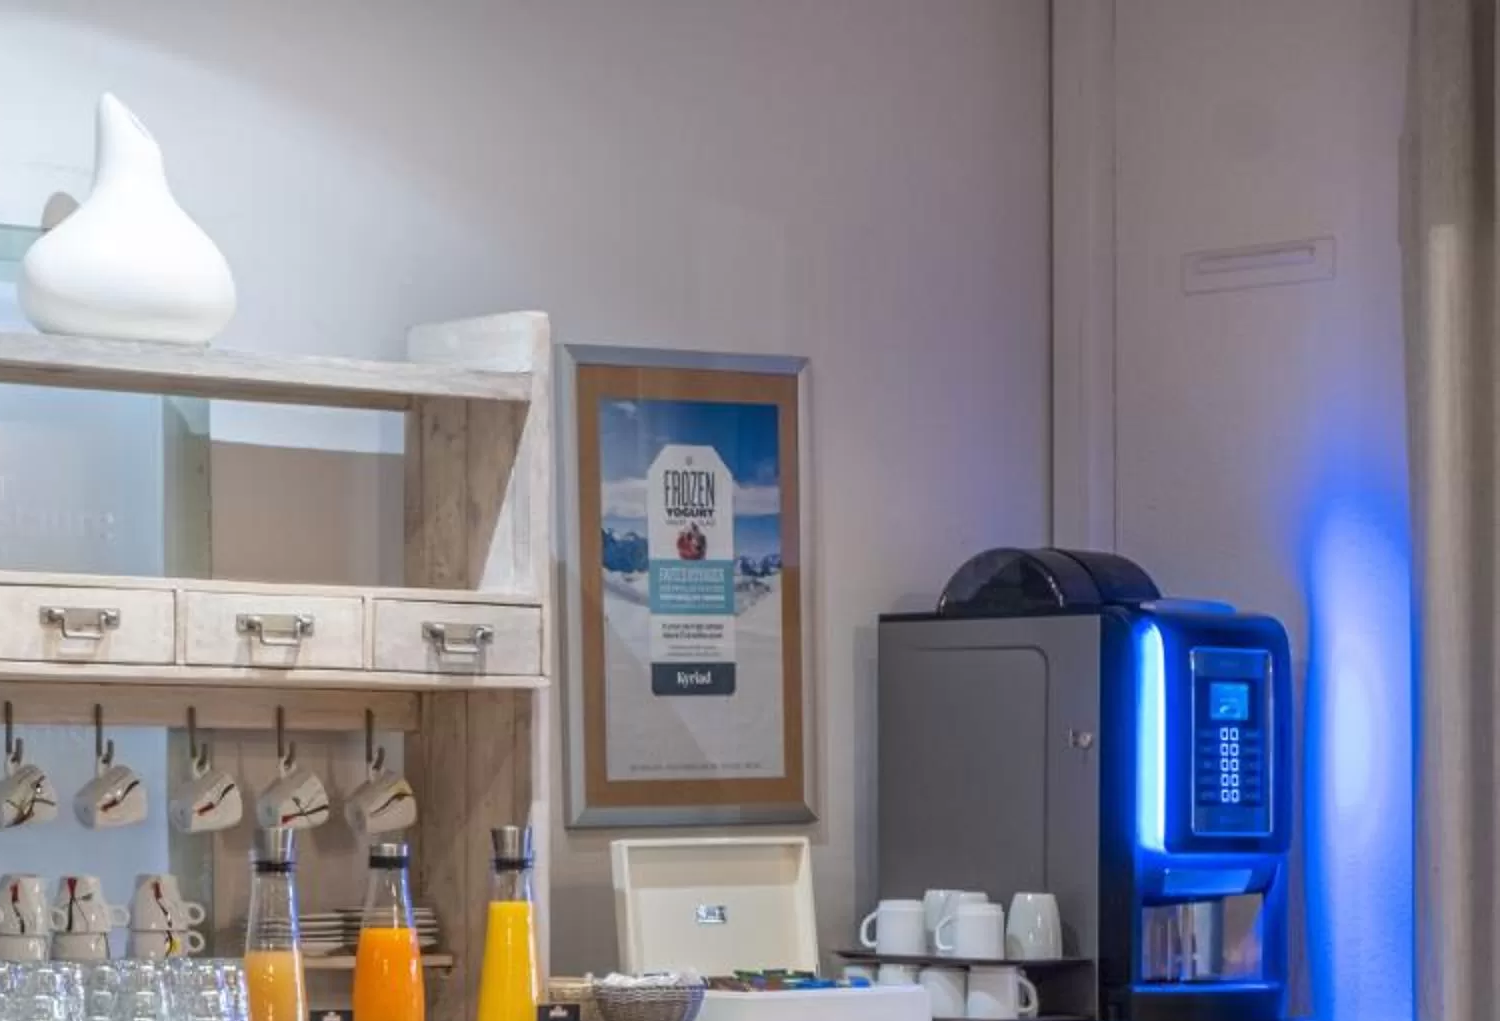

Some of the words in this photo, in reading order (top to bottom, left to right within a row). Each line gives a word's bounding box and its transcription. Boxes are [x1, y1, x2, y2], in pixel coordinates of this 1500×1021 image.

[664, 470, 715, 506] FROZEN
[666, 507, 714, 518] YOGURT
[676, 670, 712, 689] Kyriad
